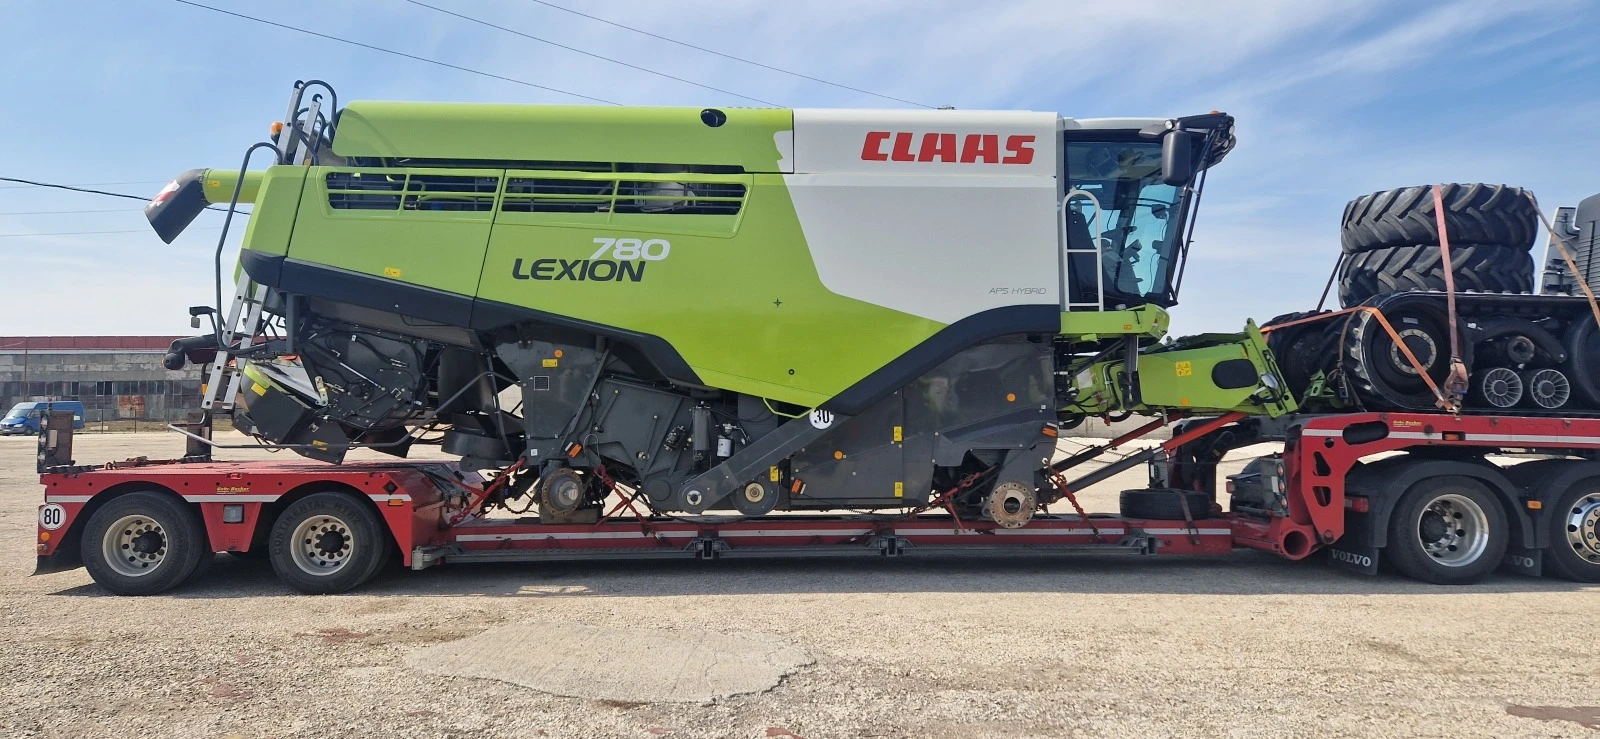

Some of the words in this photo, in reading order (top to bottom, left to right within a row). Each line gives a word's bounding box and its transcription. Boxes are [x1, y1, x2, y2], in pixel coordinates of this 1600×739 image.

[861, 131, 1036, 164] CLAAS
[589, 237, 671, 261] 780
[512, 258, 646, 282] LEXION
[989, 287, 1009, 295] APS
[1011, 287, 1047, 295] HYBRID
[813, 408, 830, 424] 30
[44, 508, 60, 525] 80
[274, 500, 324, 556] CONTINENTAL
[1331, 549, 1371, 567] VOLVO
